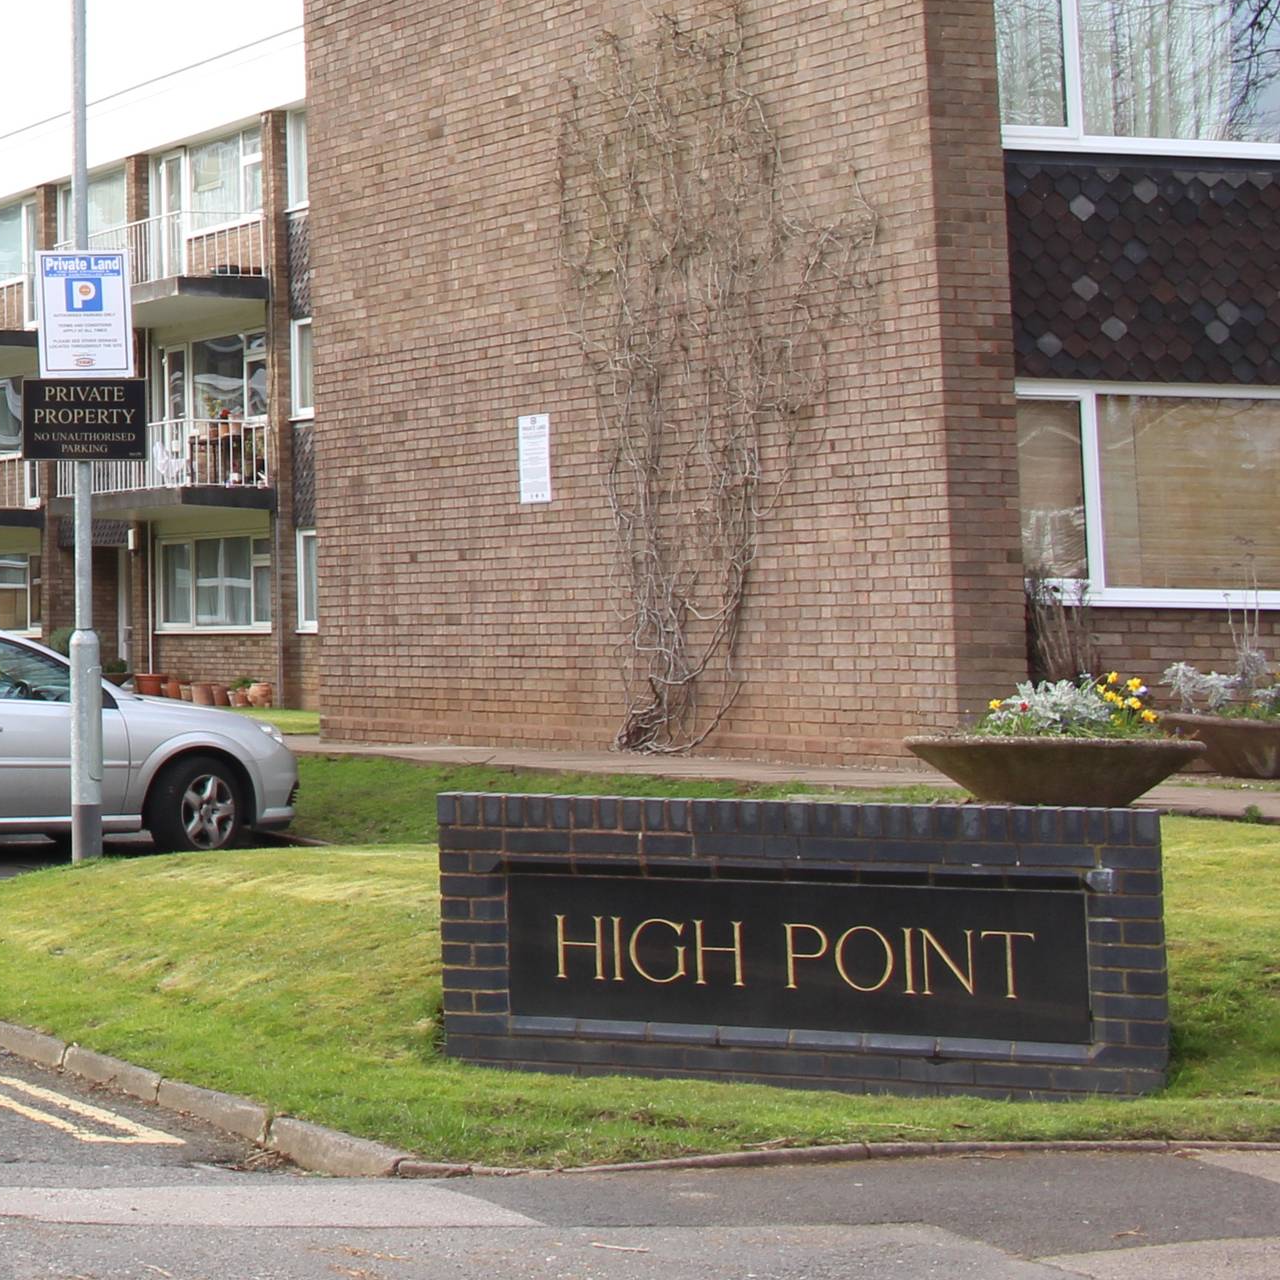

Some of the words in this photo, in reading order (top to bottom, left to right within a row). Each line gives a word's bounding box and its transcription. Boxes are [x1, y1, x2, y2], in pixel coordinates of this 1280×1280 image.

[45, 256, 88, 271] Private
[90, 256, 120, 271] Land
[44, 386, 126, 402] PRIVATE
[33, 408, 136, 424] PROPERTY
[33, 432, 50, 441] NO
[51, 432, 136, 441] UNAUTHORISED
[61, 443, 108, 453] PARKING
[555, 914, 746, 987] HIGH
[783, 922, 1036, 1001] POINT
